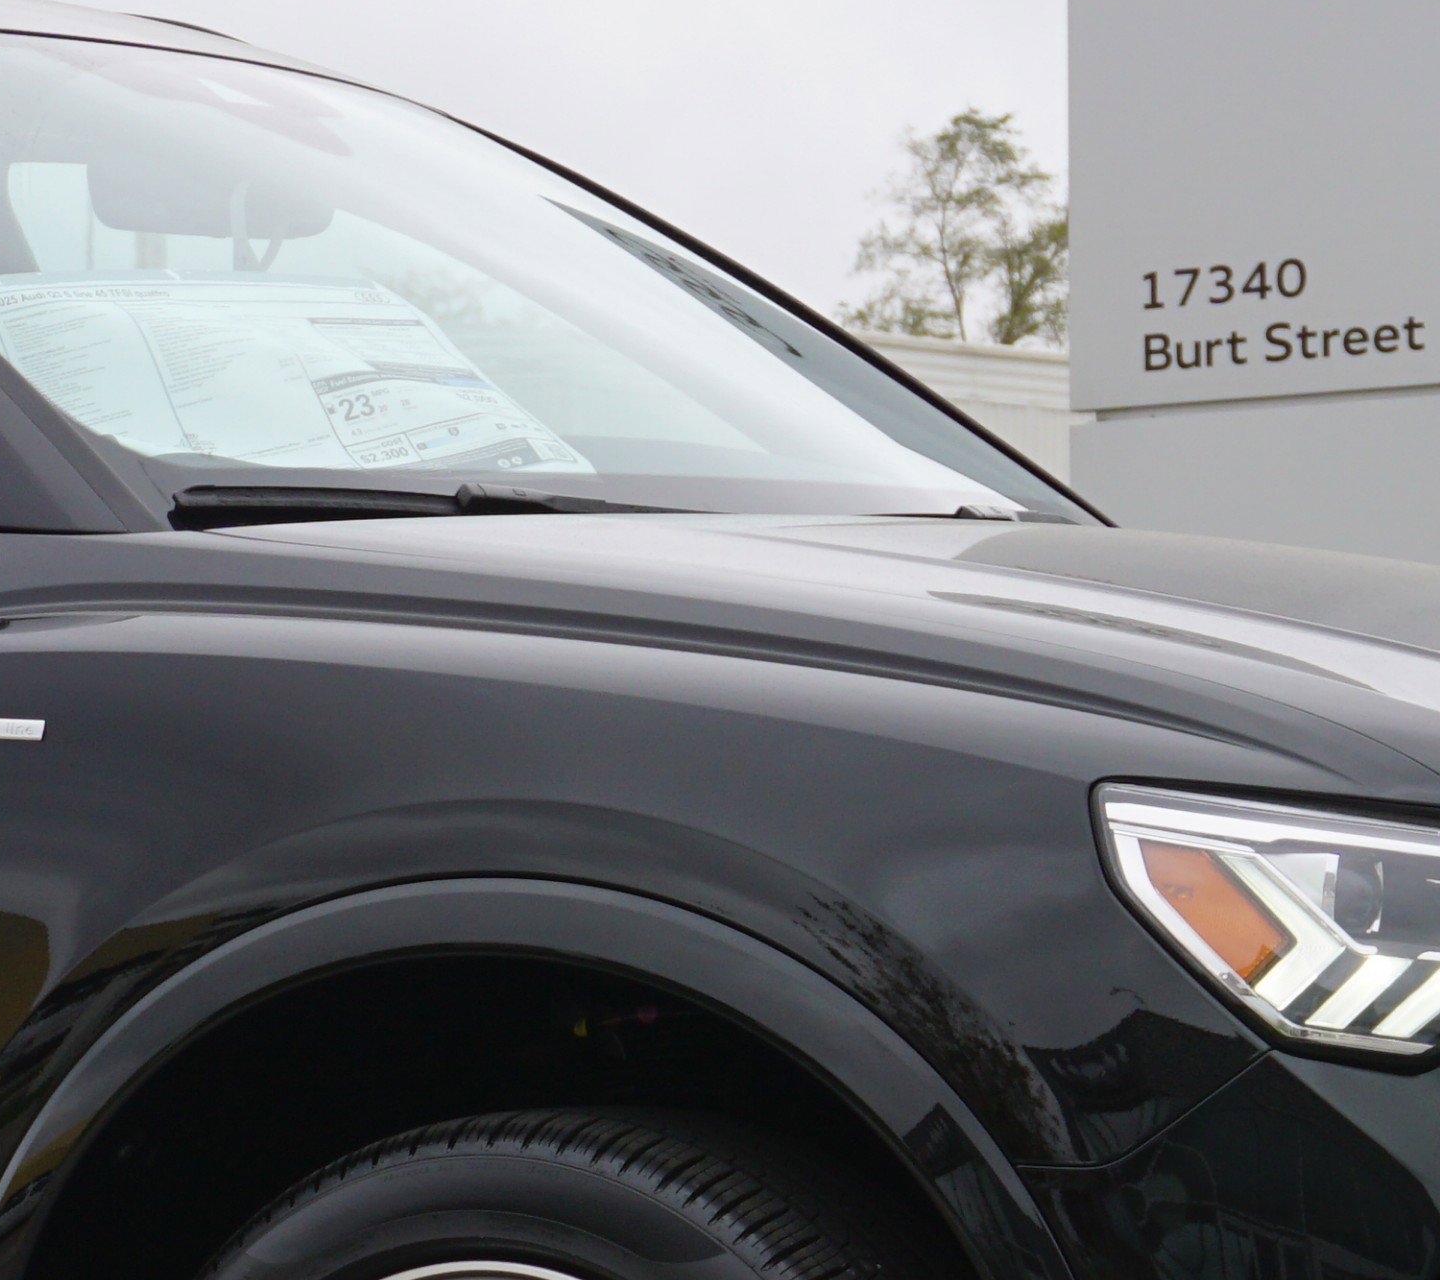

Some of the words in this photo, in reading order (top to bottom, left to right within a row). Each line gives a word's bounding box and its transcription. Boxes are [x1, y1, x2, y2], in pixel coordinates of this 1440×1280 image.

[1141, 258, 1308, 310] 17340
[21, 291, 45, 303] Audi
[1143, 330, 1248, 372] Burt
[1264, 315, 1426, 363] Street
[338, 394, 376, 422] 23
[359, 447, 410, 464] $2,300
[5, 722, 34, 736] line
